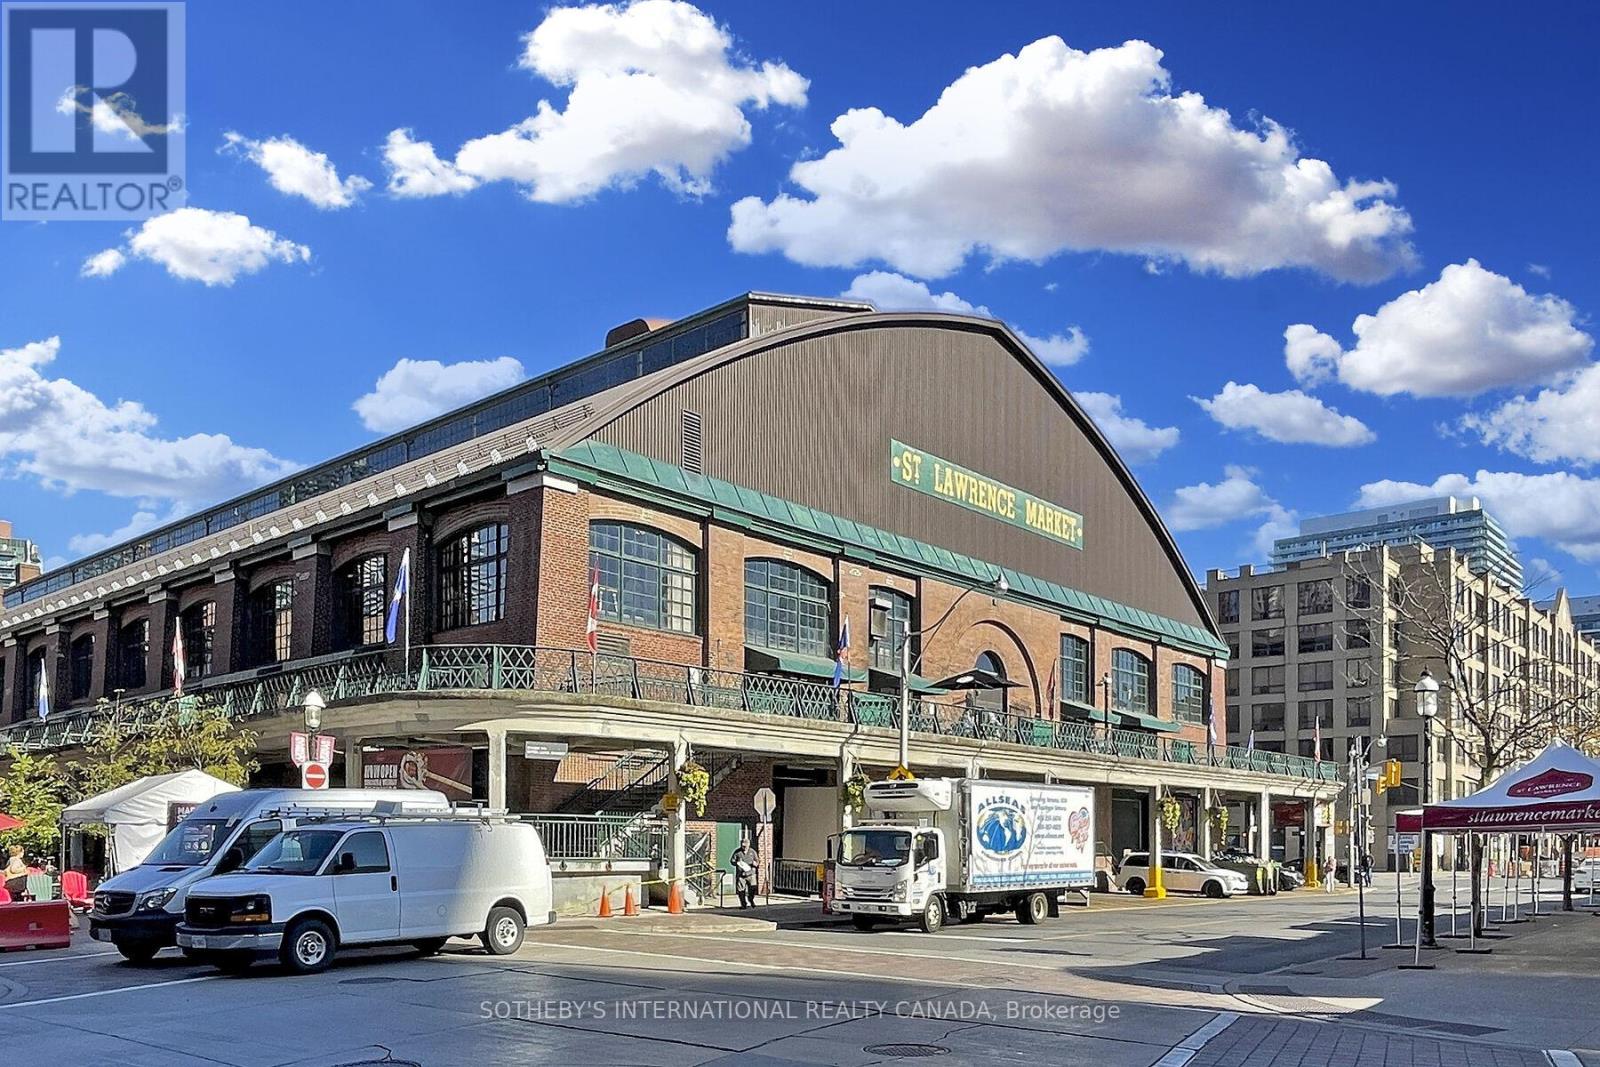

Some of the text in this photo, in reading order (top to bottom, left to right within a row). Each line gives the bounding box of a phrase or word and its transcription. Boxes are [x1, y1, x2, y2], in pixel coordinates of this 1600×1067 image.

[934, 463, 1016, 519] LAWRENCE
[1025, 499, 1077, 542] MARKET
[1527, 782, 1581, 793] LAWRENCE
